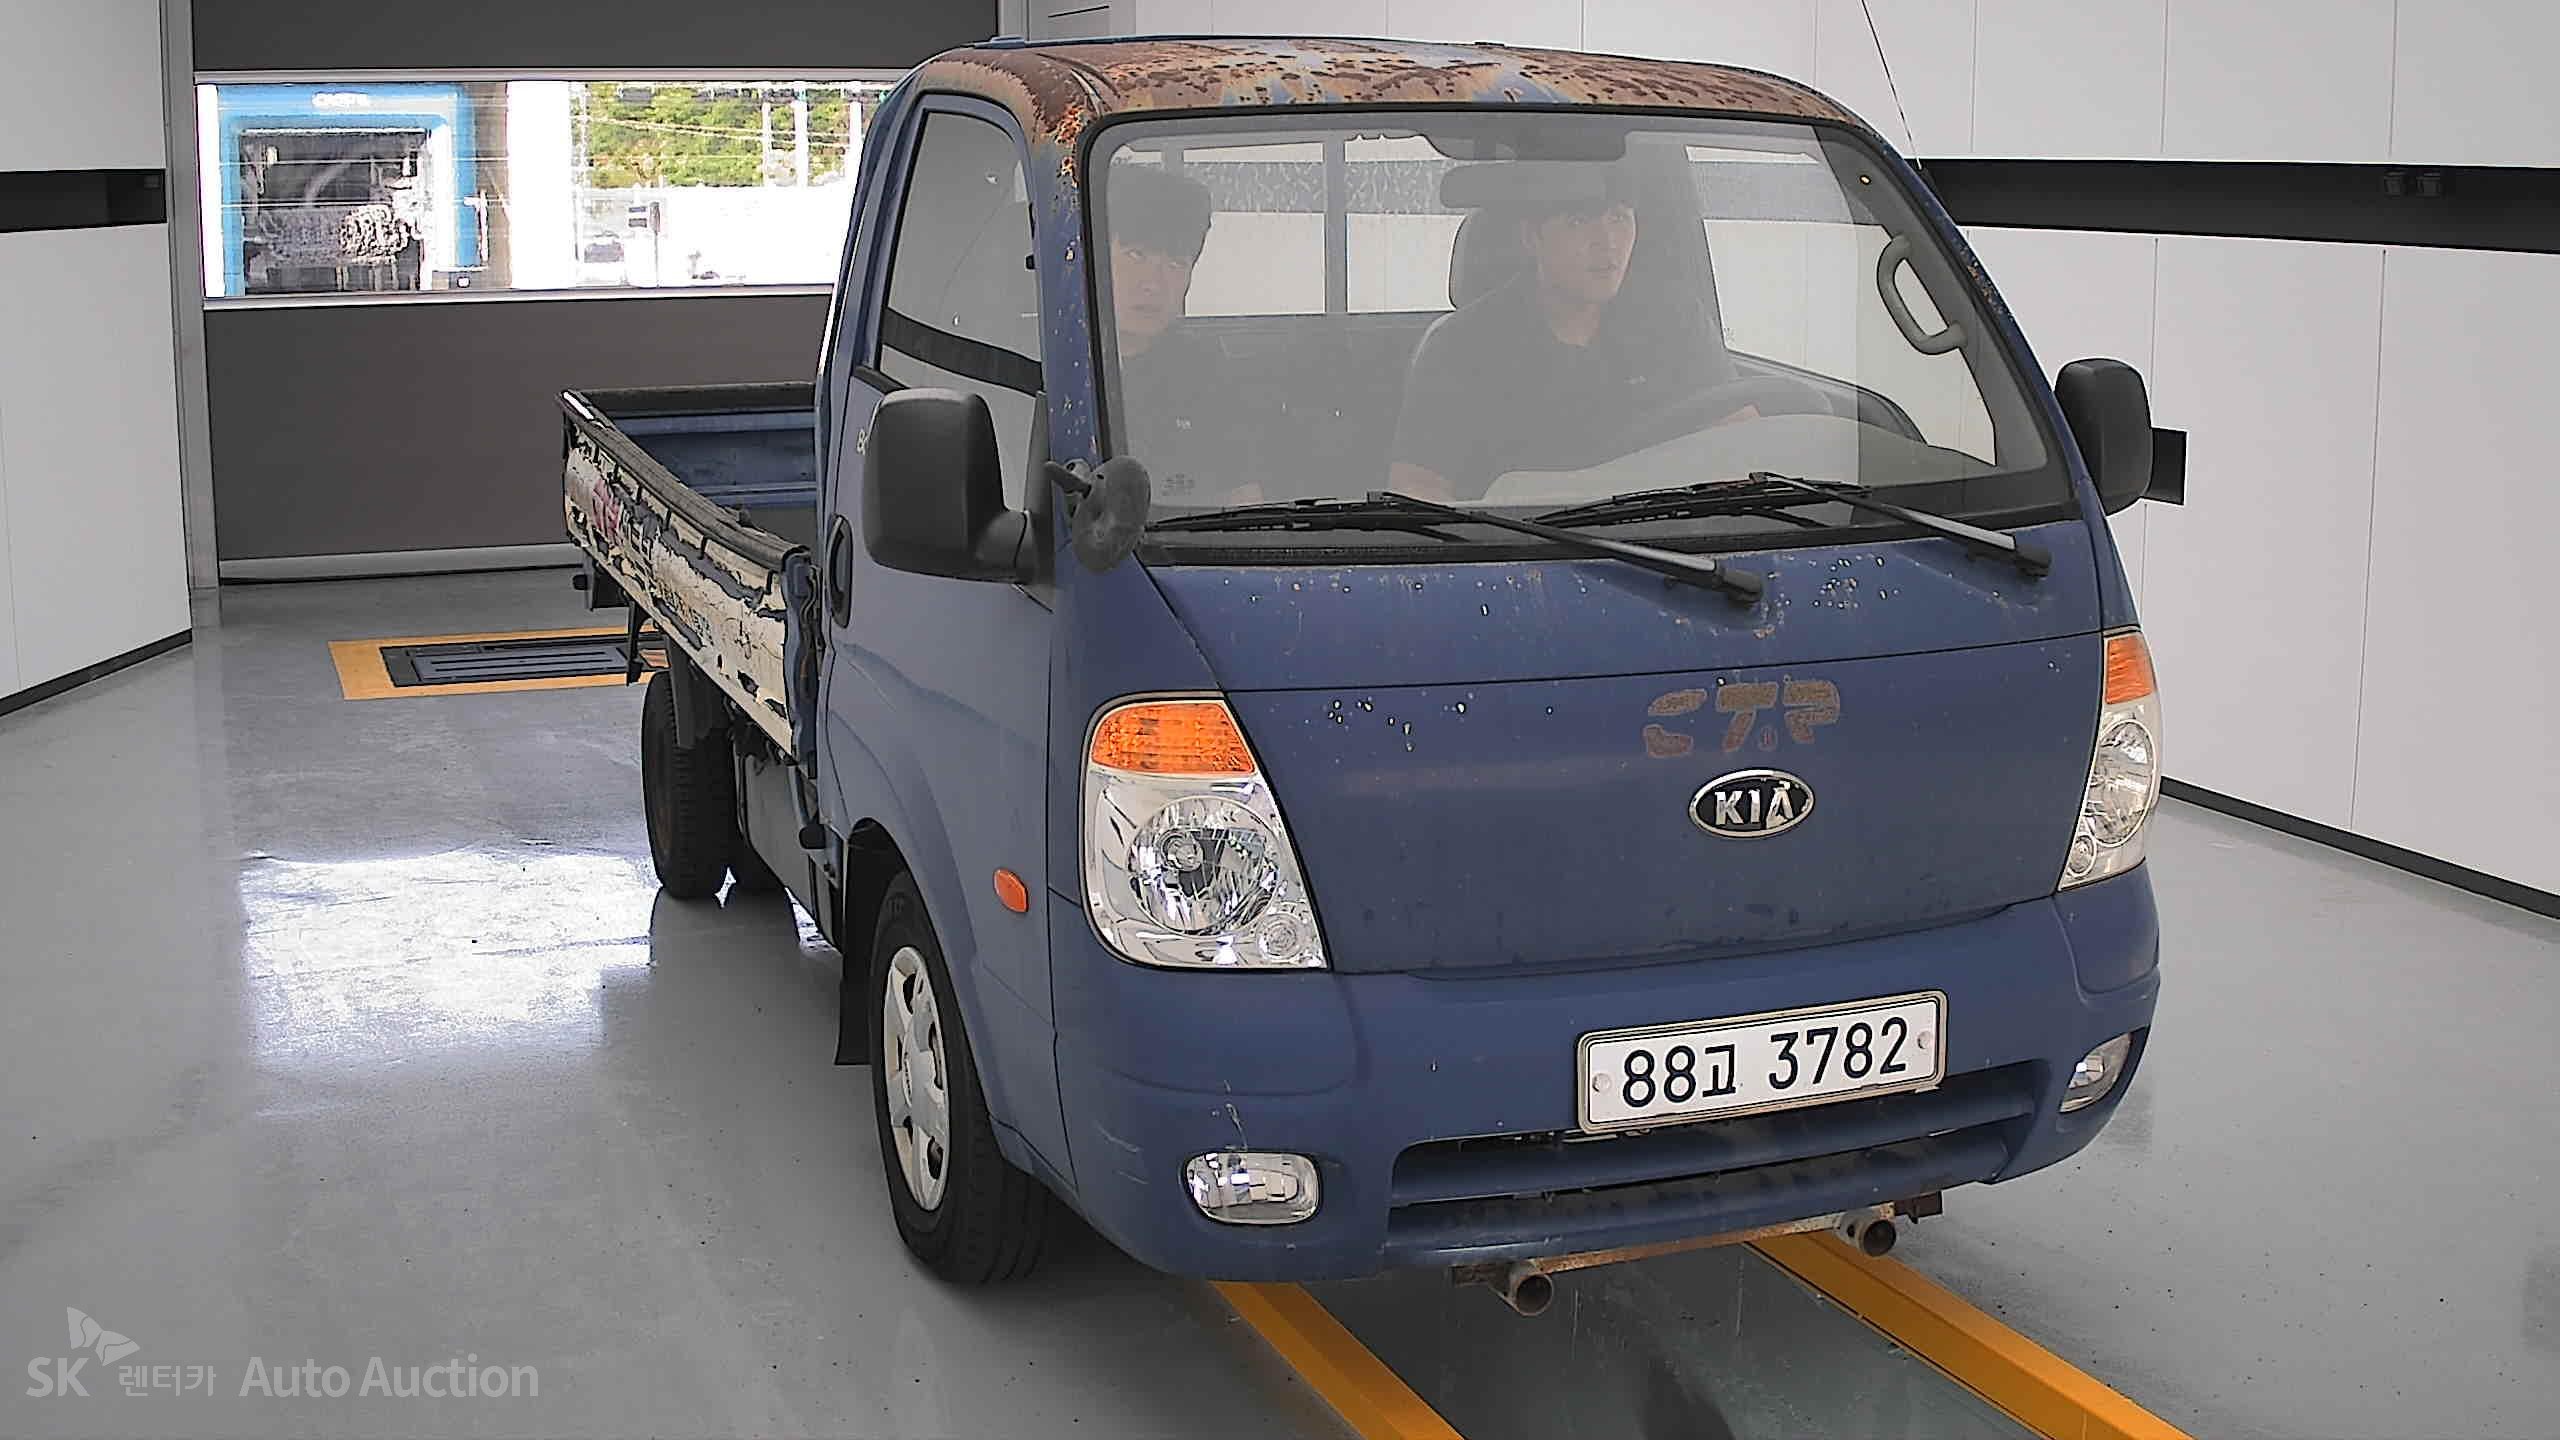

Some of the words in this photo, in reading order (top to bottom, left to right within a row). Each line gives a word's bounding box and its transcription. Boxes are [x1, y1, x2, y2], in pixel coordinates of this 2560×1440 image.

[1713, 780, 1795, 830] KIA
[1622, 1043, 1737, 1109] 88고
[1768, 1016, 1909, 1091] 3782
